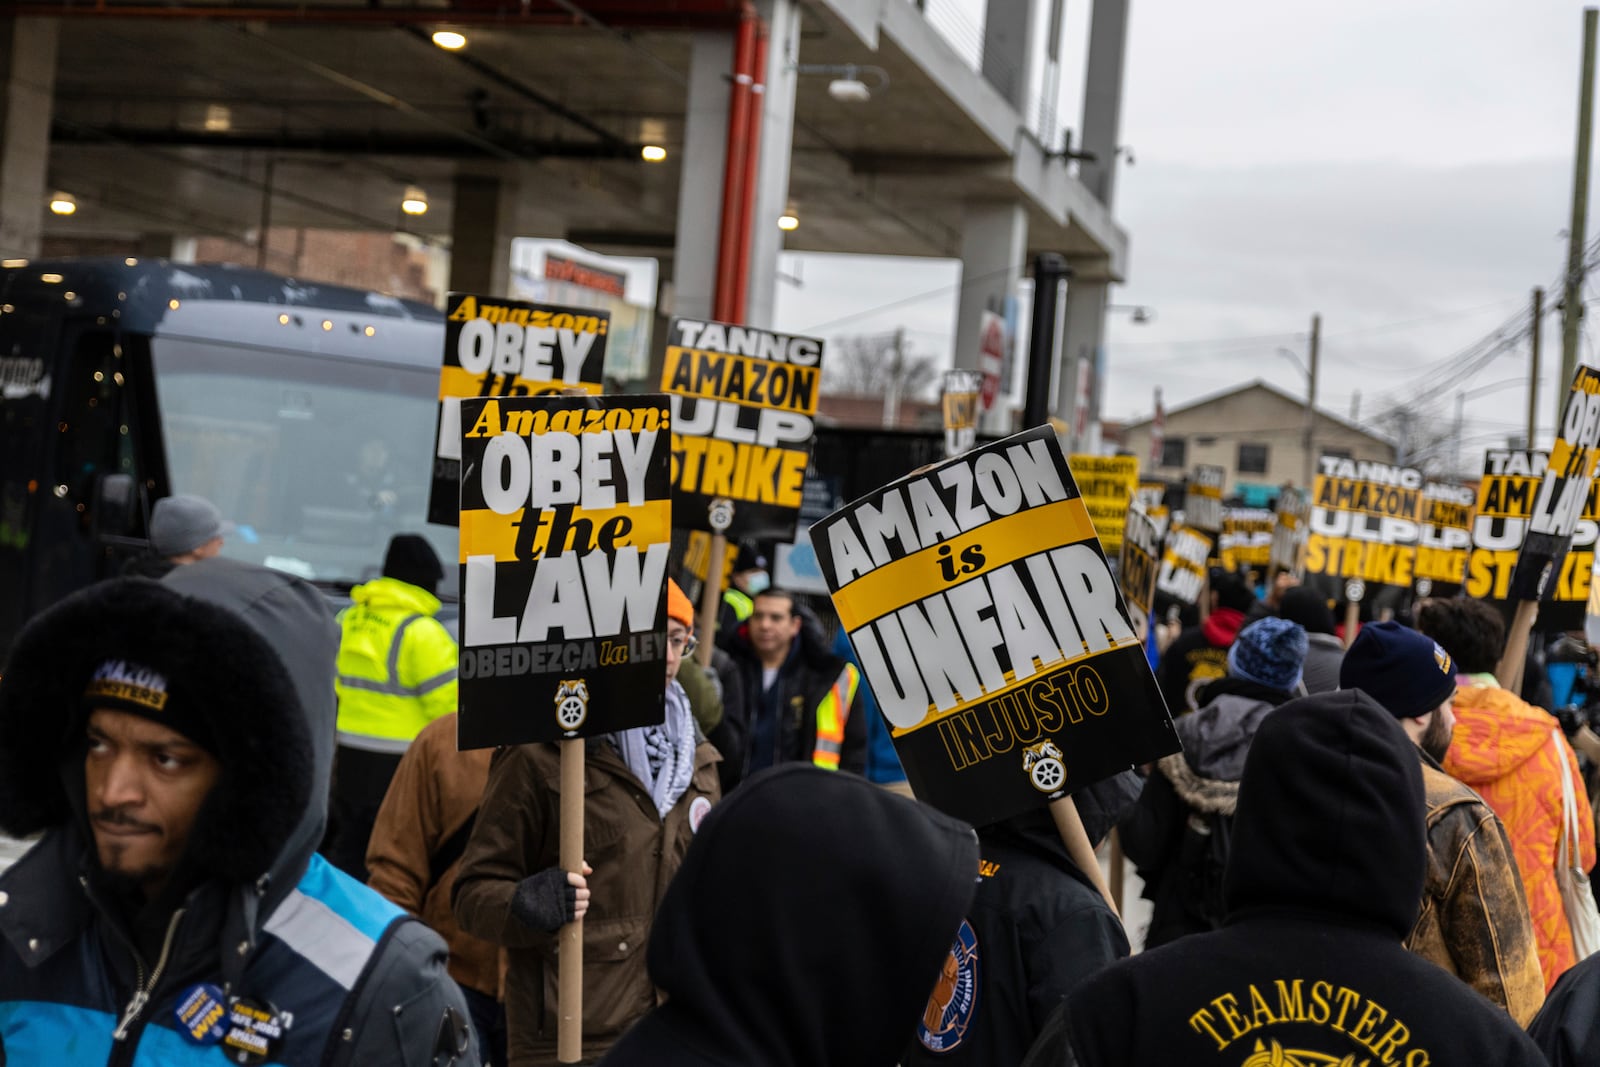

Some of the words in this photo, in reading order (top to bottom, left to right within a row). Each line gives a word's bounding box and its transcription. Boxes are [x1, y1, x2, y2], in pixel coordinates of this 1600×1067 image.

[449, 296, 607, 335] Amazon:
[458, 317, 597, 385] OBEY
[676, 319, 819, 366] TANNC
[671, 352, 814, 410] AMAZON
[465, 399, 670, 438] Amazon:
[671, 394, 814, 447] ULP
[481, 428, 658, 515] OBEY
[1320, 456, 1422, 490] TANNC
[827, 438, 1067, 588] AMAZON
[1320, 479, 1417, 519] AMAZON
[1530, 469, 1592, 536] LAW
[511, 502, 633, 561] the
[1310, 506, 1420, 545] ULP
[1419, 523, 1471, 550] LP
[1473, 516, 1599, 551] UP
[936, 544, 987, 583] is
[1305, 533, 1414, 587] STRIKE
[1466, 548, 1594, 600] STKE
[464, 542, 670, 647] LAW
[460, 638, 597, 680] OBEDEZCA
[600, 640, 628, 667] la
[629, 632, 668, 664] LEY
[851, 543, 1140, 730] UNFAIR
[937, 664, 1109, 772] INJUSTO
[959, 969, 973, 1014] RISING
[191, 1004, 225, 1040] WIN
